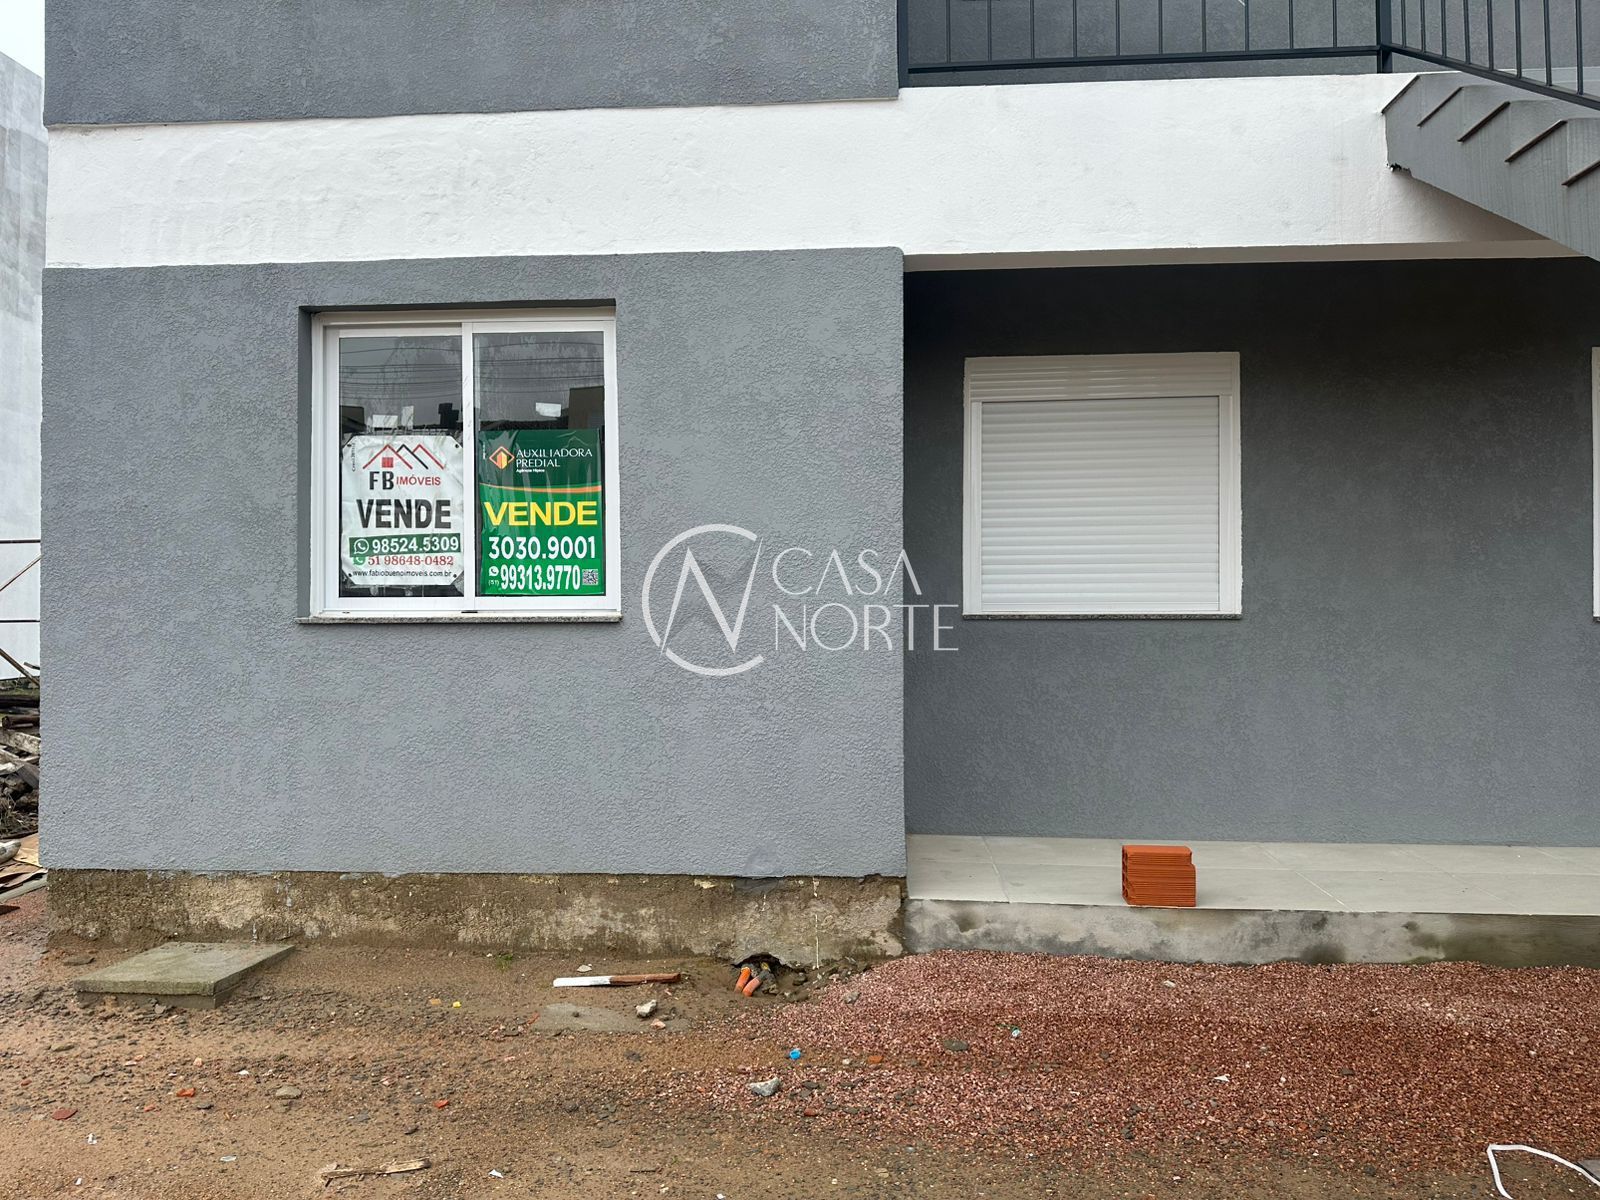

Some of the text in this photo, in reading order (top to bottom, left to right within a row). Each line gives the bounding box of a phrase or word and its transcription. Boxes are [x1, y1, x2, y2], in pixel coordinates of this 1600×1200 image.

[516, 458, 560, 468] PREDIAL
[369, 471, 441, 490] FB IMÓVEIS
[356, 499, 452, 529] VENDE
[484, 501, 598, 526] VENDE
[372, 536, 459, 554] 98524.5309
[488, 536, 596, 560] 3030.9001
[368, 555, 454, 566] 51 98648-0482
[352, 568, 452, 578] www.fabiobuenoimoveis.com.br
[500, 564, 580, 590] 99313.9770
